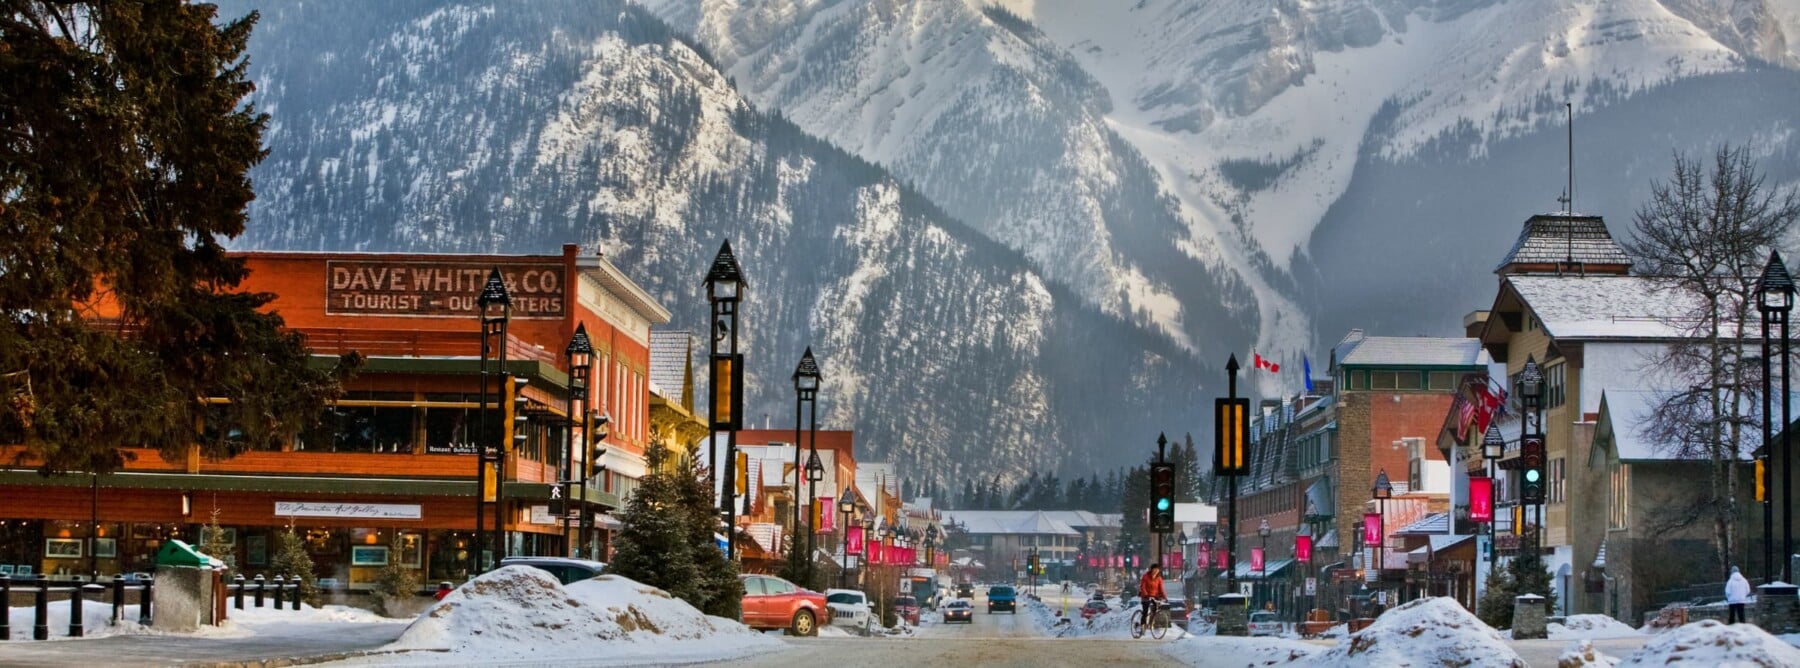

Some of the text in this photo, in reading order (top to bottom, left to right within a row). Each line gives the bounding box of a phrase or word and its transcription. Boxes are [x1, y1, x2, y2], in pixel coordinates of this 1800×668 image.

[333, 267, 406, 291] DAVE
[504, 272, 519, 293] &
[522, 270, 562, 294] CO.
[341, 293, 422, 310] TOURIST
[449, 296, 561, 312] OUTERS
